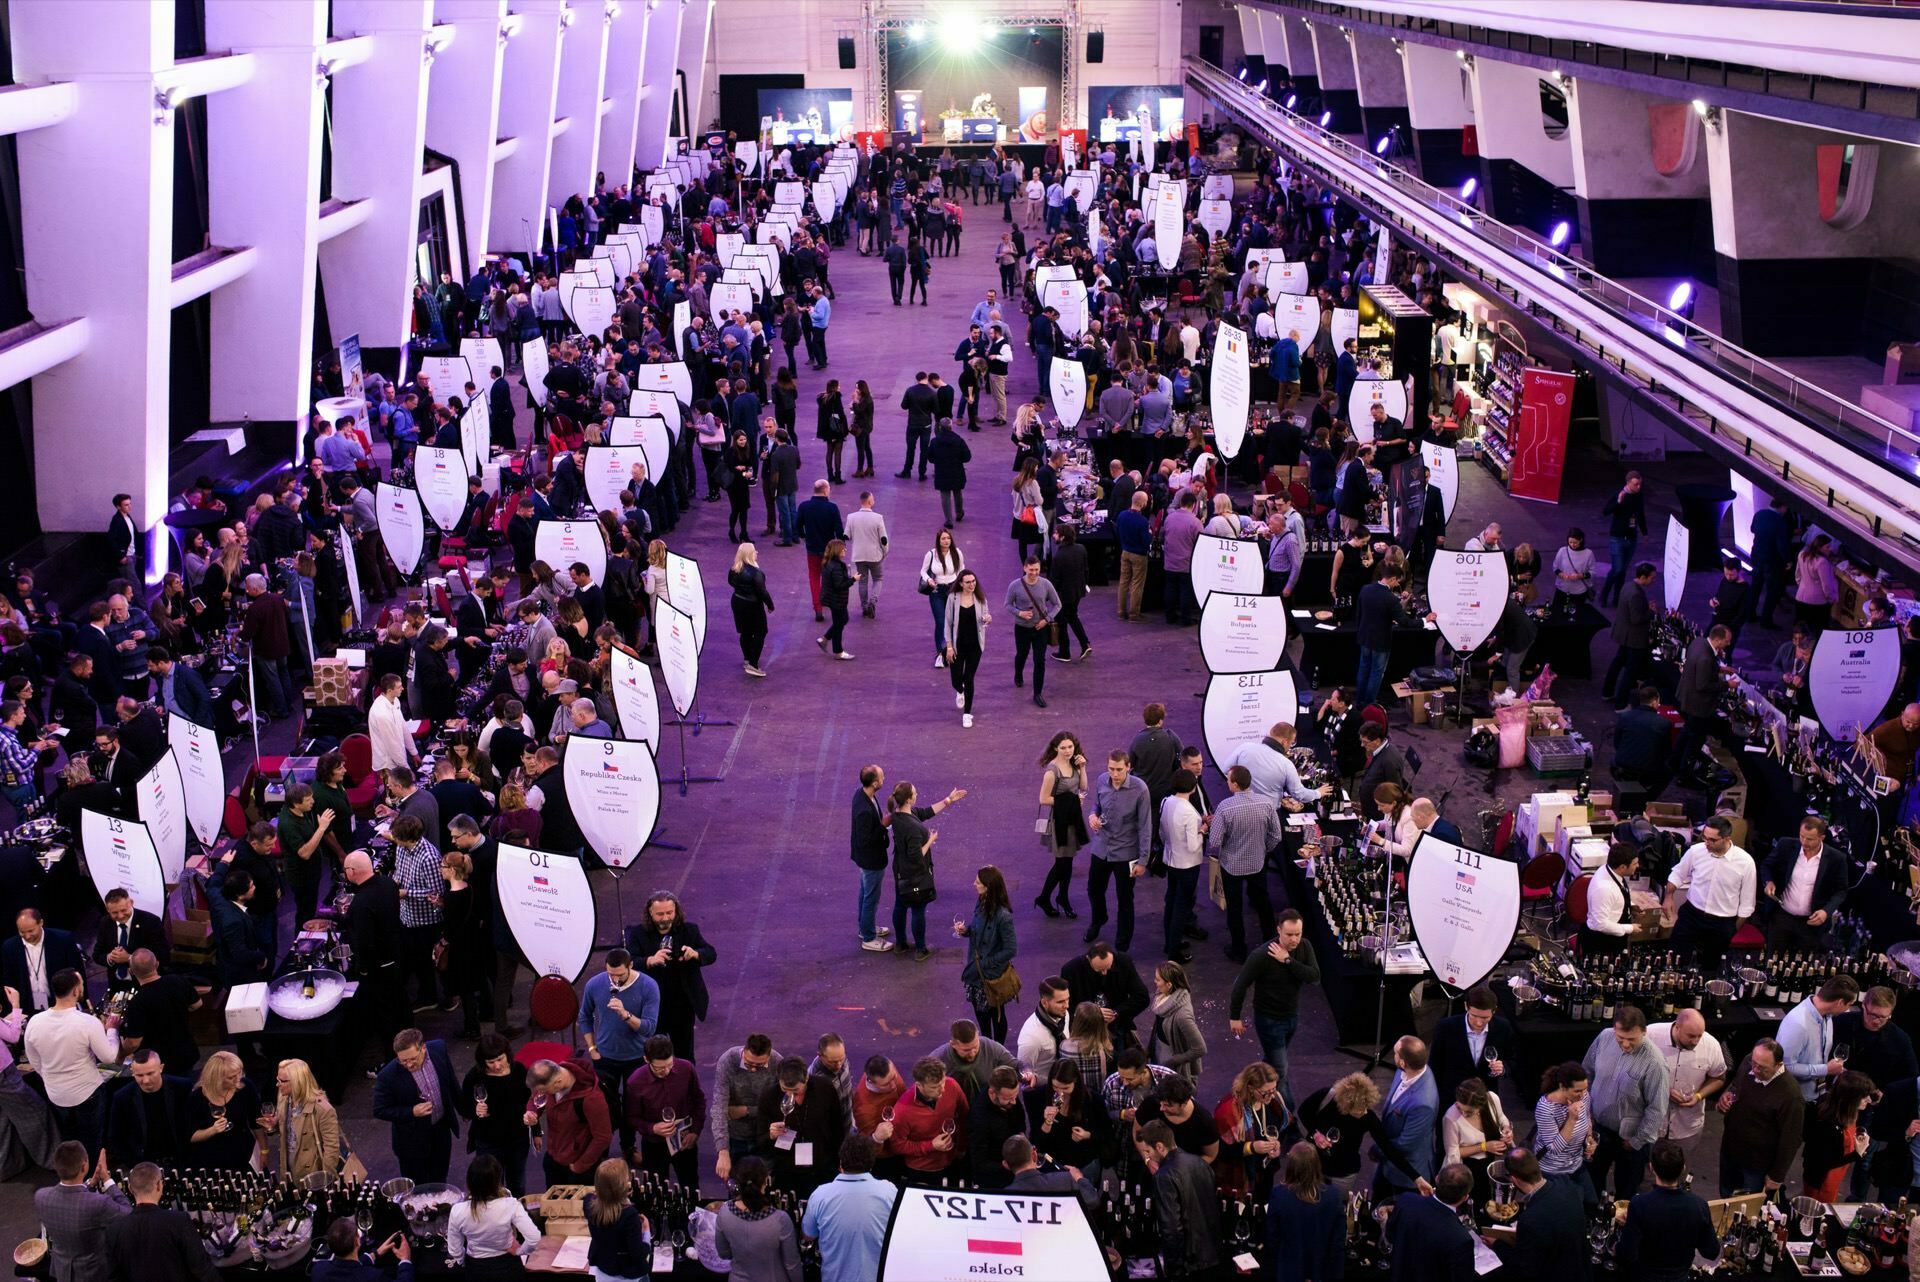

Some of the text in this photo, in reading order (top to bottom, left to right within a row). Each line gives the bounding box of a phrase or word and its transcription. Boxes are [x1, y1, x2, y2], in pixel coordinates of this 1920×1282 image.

[1293, 296, 1304, 304] 36
[434, 449, 445, 459] 18
[393, 487, 402, 497] 17
[1218, 539, 1239, 553] 115
[1233, 596, 1258, 609] 114
[1844, 631, 1874, 644] 108
[186, 721, 199, 738] 12
[603, 742, 614, 756] 9
[580, 769, 642, 782] Republika Czeska
[107, 817, 123, 833] 13
[1454, 848, 1482, 871] 111
[1455, 882, 1473, 895] USA
